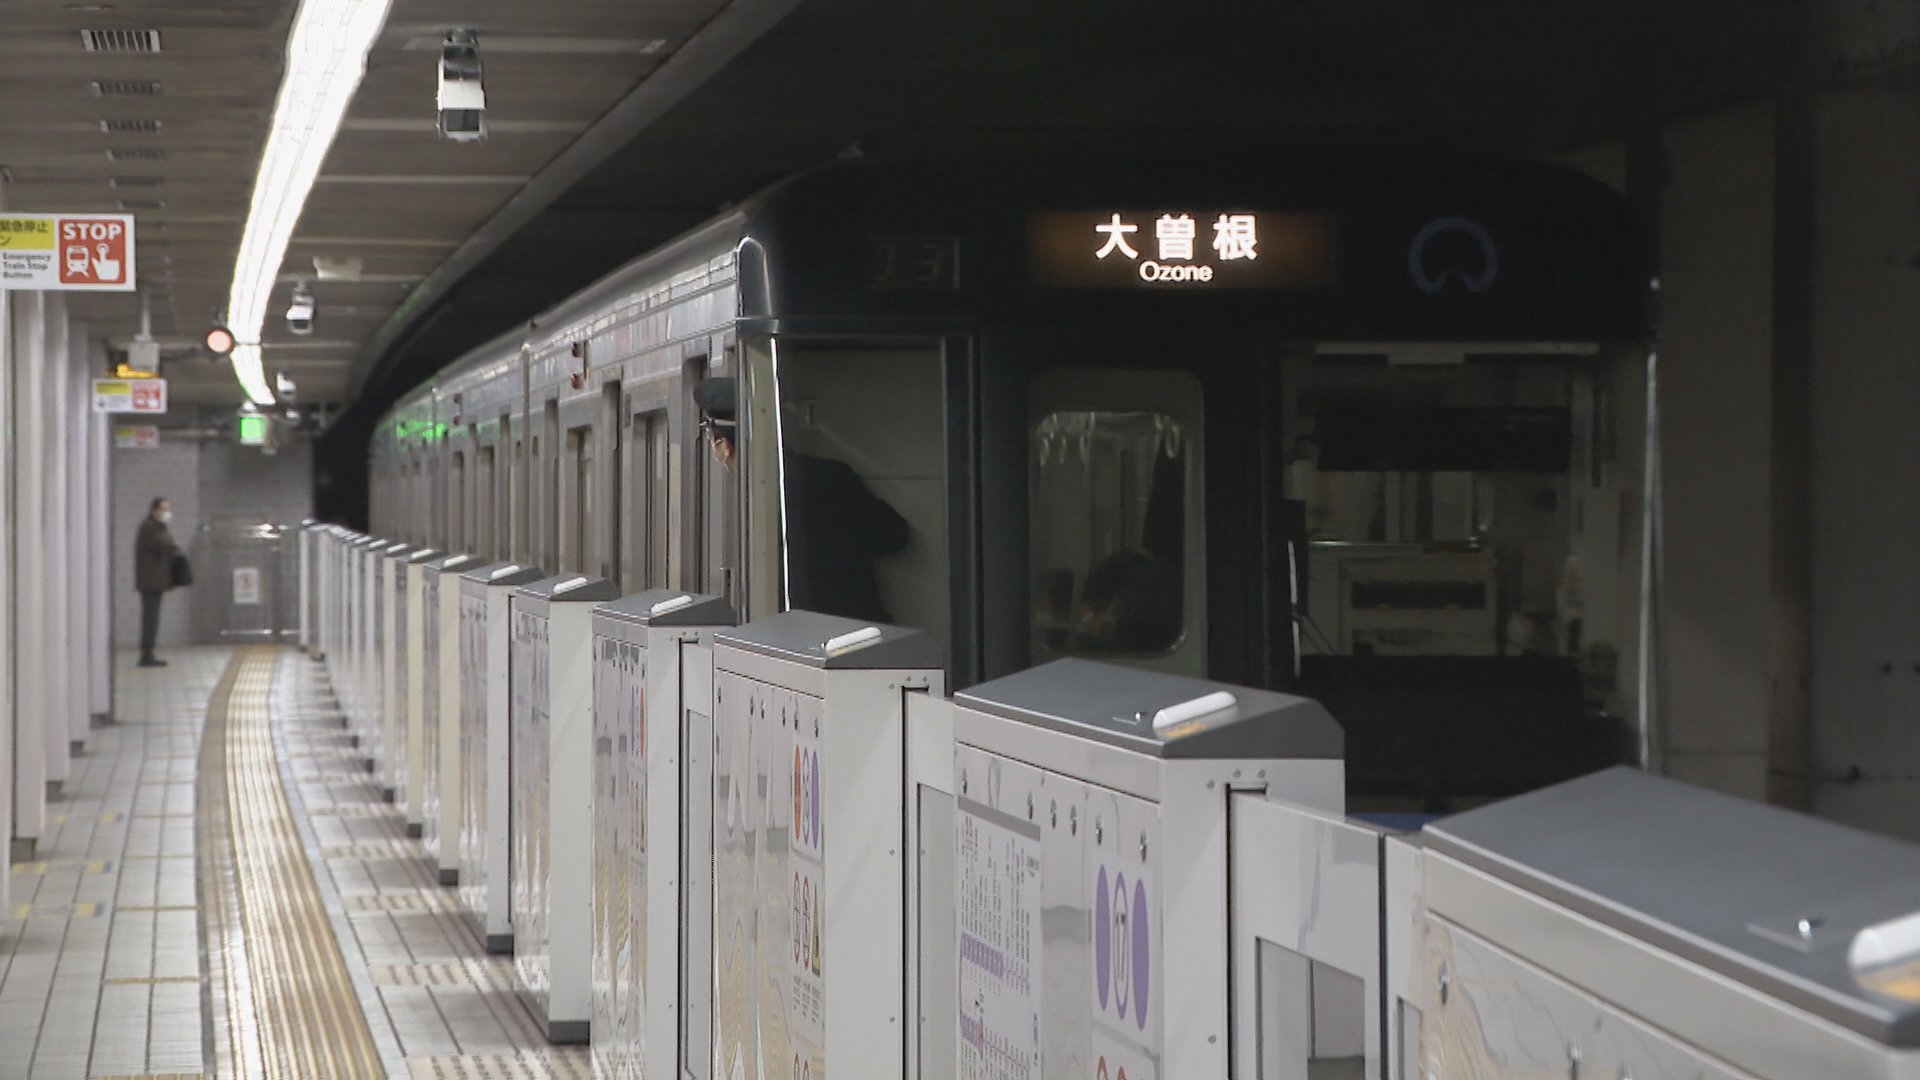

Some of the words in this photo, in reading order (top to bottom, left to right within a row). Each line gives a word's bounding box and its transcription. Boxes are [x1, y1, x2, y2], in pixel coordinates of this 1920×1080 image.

[63, 222, 122, 240] STOP
[1095, 213, 1258, 260] 大曽根
[1139, 261, 1214, 283] Ozone
